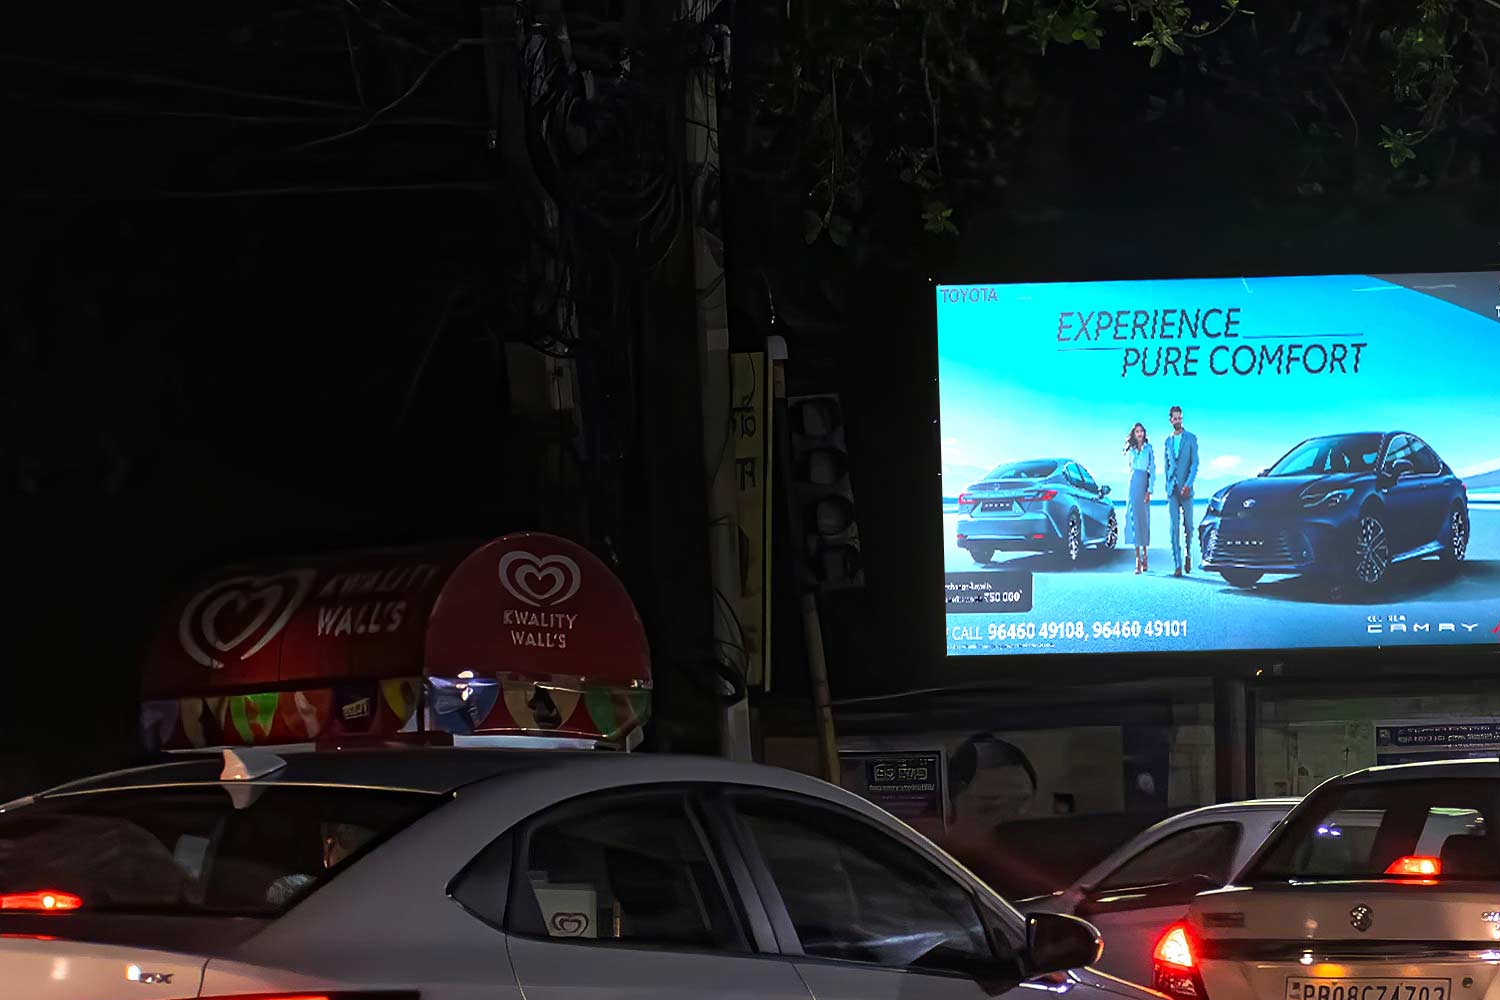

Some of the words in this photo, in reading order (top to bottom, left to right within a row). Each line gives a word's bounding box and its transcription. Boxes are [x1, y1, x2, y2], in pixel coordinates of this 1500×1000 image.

[939, 287, 999, 303] TOYOTA
[1056, 307, 1241, 342] EXPERIENCE
[1121, 345, 1201, 378] PURE
[1208, 342, 1368, 377] COMFORT
[316, 601, 408, 638] WALL'S
[502, 608, 579, 631] KWALITY
[951, 625, 983, 641] CALL
[987, 623, 1036, 640] 96460
[1038, 621, 1089, 642] 49108,
[1092, 620, 1141, 639] 96460
[1144, 619, 1188, 638] 49101
[510, 629, 567, 649] WALL'S
